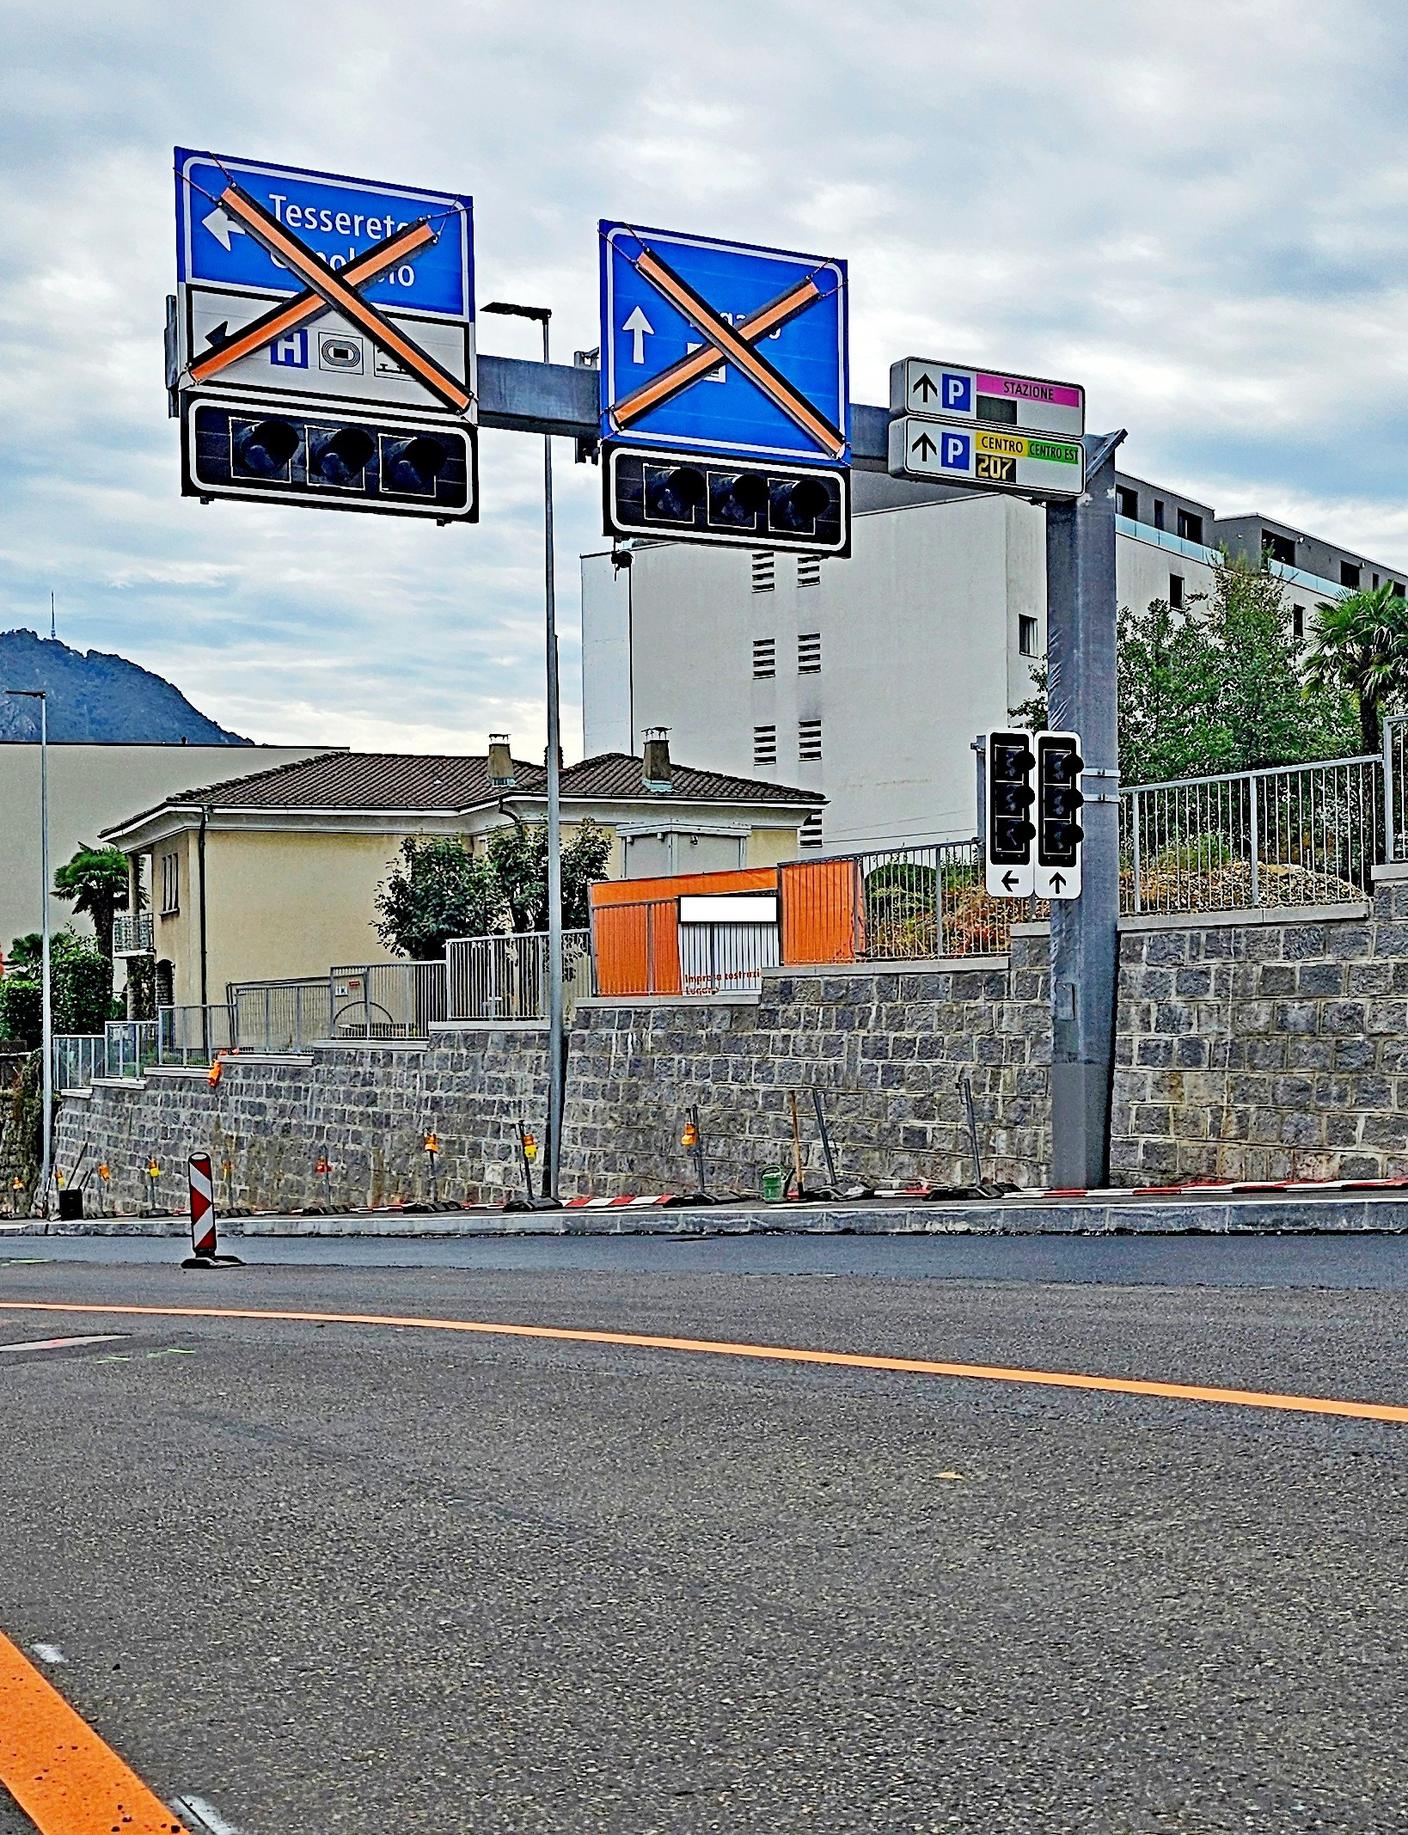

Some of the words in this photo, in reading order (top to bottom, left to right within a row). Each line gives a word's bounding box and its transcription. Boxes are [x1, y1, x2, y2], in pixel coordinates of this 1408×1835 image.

[277, 332, 302, 364] H
[949, 379, 964, 405] P
[1003, 380, 1054, 401] STAZIONE
[947, 437, 964, 464] P
[981, 436, 1024, 454] CENTRO
[1029, 443, 1062, 460] CENTRO
[1064, 448, 1079, 461] EST
[977, 454, 1013, 481] 207
